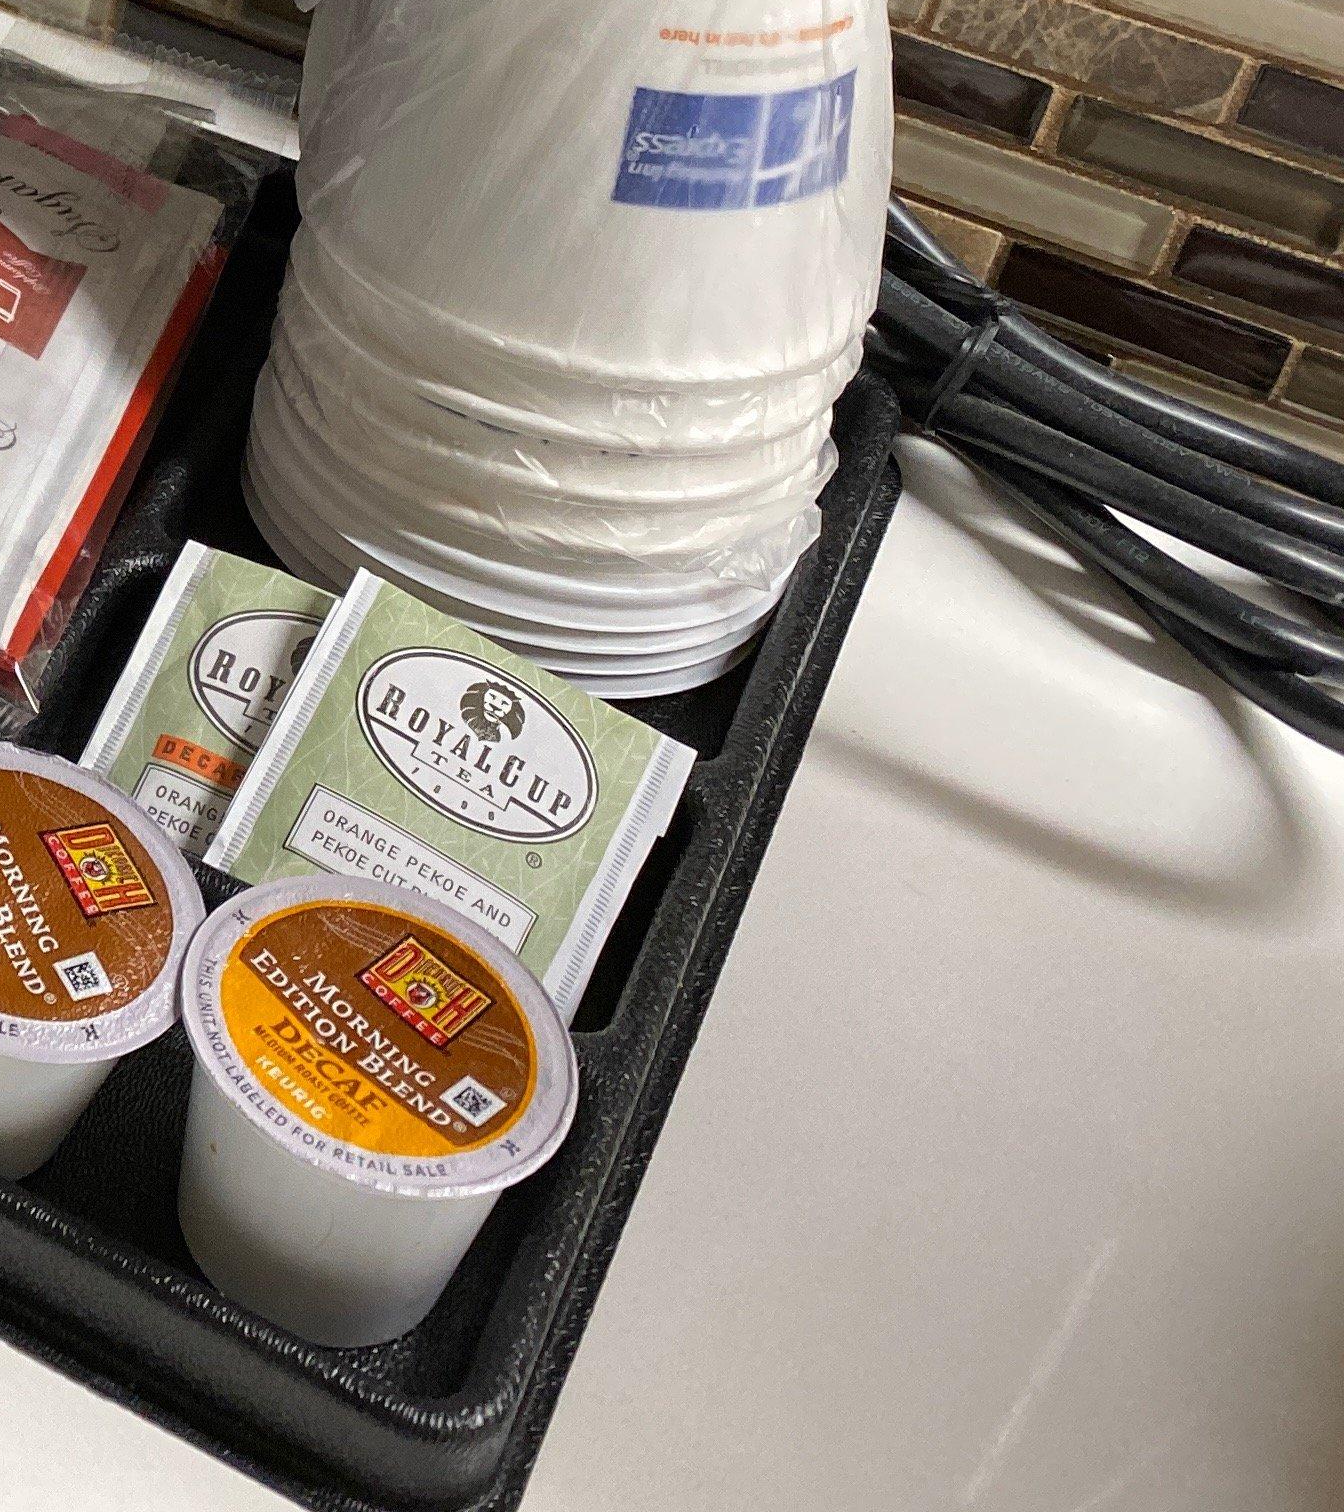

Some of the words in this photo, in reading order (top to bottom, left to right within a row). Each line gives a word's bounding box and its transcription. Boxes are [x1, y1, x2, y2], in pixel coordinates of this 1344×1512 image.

[156, 785, 225, 824] ORANG
[431, 751, 494, 798] TEA
[48, 835, 99, 915] COFFEE
[311, 830, 369, 870] PEKOE
[372, 864, 407, 888] CUT
[323, 809, 401, 859] ORANGE
[406, 856, 469, 900] PEKOE
[471, 898, 511, 928] AND
[199, 958, 218, 989] THIS
[250, 948, 358, 1054] EDITION
[199, 992, 216, 1028] UNIT
[303, 971, 437, 1088] MORNING
[361, 973, 443, 1045] COFFEE
[208, 1030, 233, 1064] NOT
[253, 1023, 297, 1065] MEDIUM
[293, 1060, 329, 1094] ROAST
[269, 1015, 389, 1113] DECAF
[226, 1064, 288, 1128] LABELED
[256, 1054, 326, 1120] KEURIG
[291, 1125, 326, 1152] FOR
[332, 1147, 397, 1175] RETAIL
[403, 1162, 448, 1178] SALE
